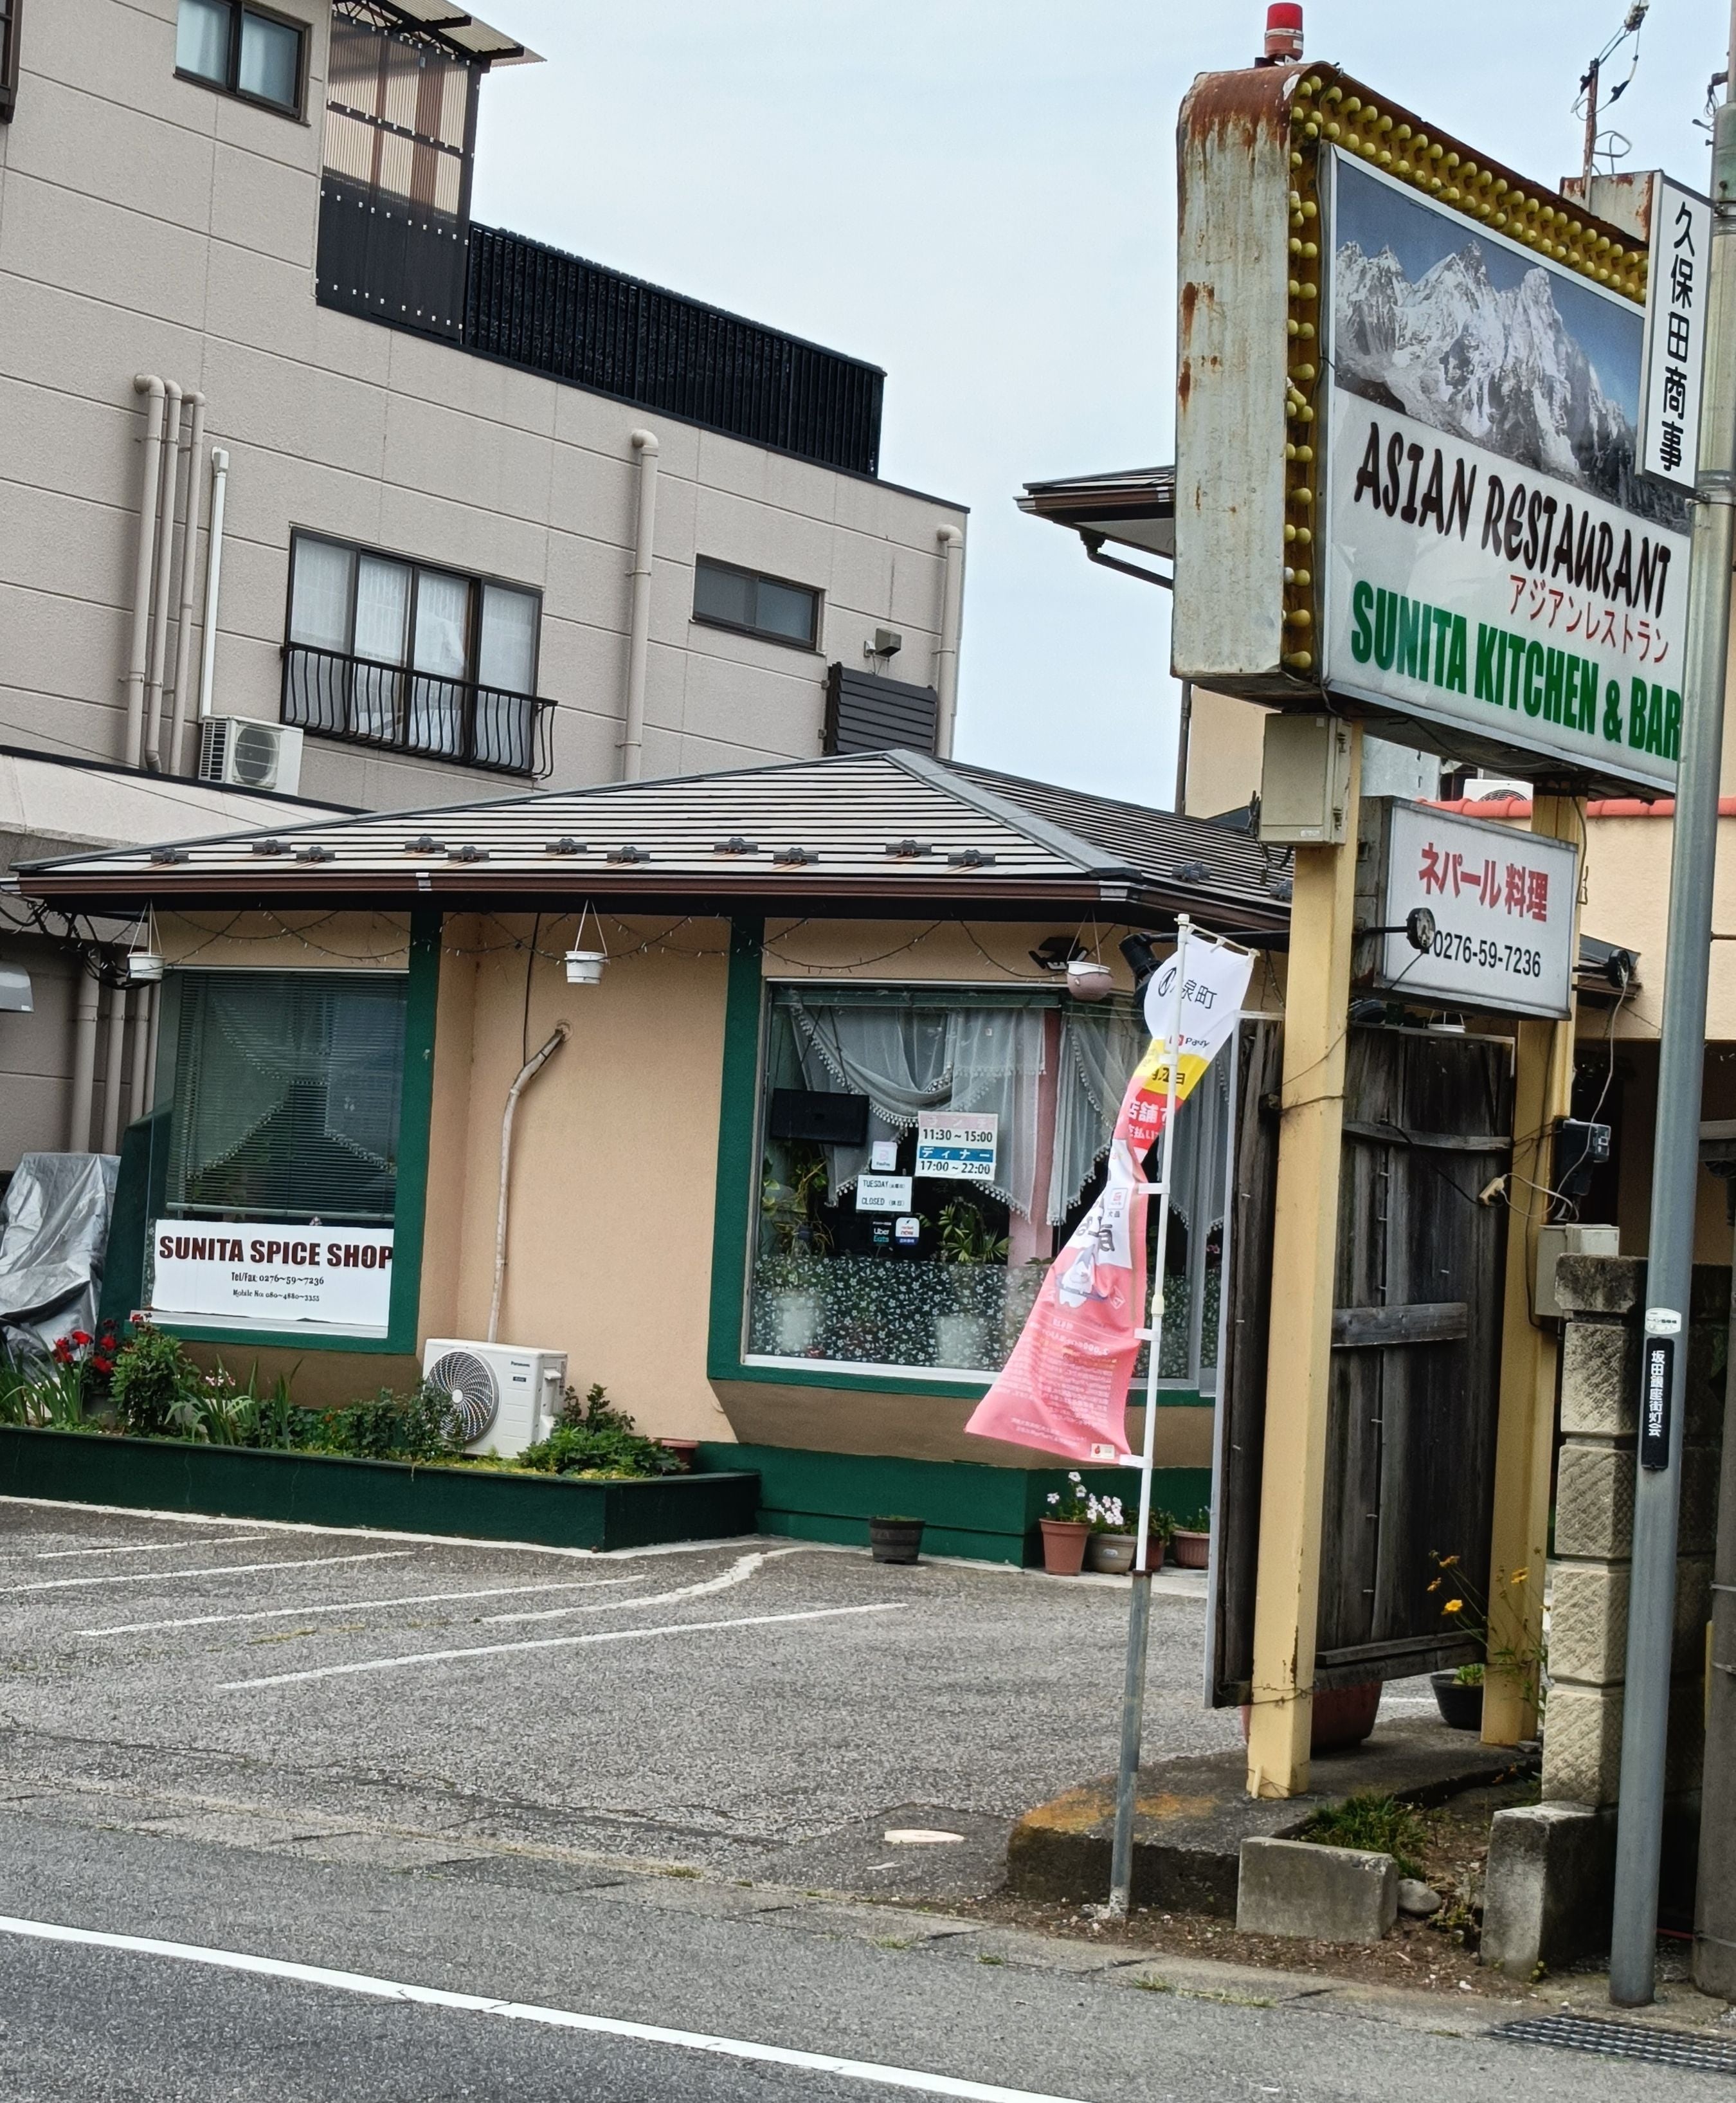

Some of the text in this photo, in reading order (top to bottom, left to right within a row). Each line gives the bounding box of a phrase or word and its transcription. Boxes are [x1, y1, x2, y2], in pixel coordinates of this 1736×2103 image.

[1659, 201, 1695, 471] 久保田商事
[1354, 422, 1671, 618] ASIAN RESTAURANT
[1510, 574, 1668, 663] アジアンレストラン
[1352, 580, 1682, 761] SUNITA KITCHEN & BAR
[1418, 842, 1548, 922] ネパール料理
[1434, 931, 1541, 978] 0276-59-7236
[923, 1129, 952, 1140] 11:30
[964, 1131, 993, 1142] 15:00
[927, 1116, 986, 1127] ランチ
[921, 1147, 990, 1160] ディナー
[921, 1161, 949, 1171] 17:00
[961, 1163, 990, 1174] 22:00
[863, 1179, 889, 1188] TUESDAY
[159, 1235, 393, 1269] SUNITA SPICE SHOP
[233, 1289, 253, 1297] Mobile
